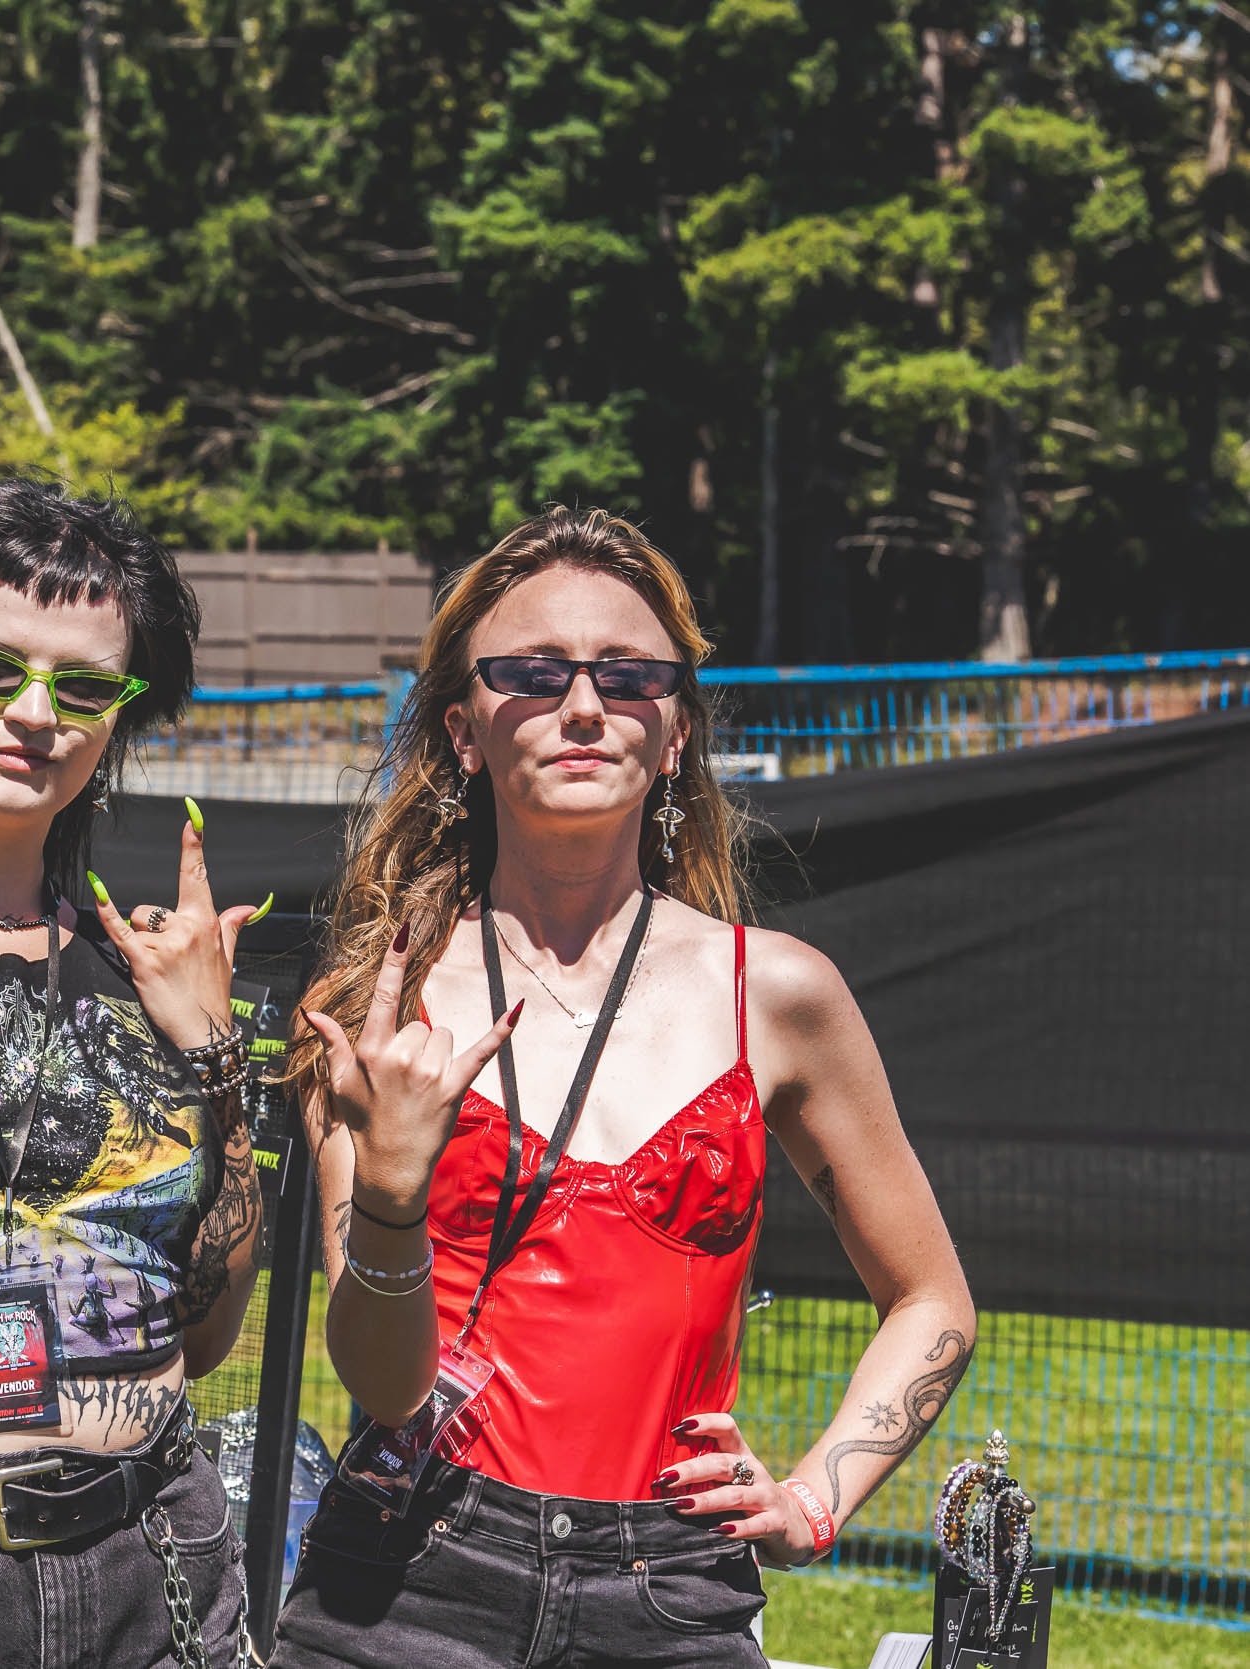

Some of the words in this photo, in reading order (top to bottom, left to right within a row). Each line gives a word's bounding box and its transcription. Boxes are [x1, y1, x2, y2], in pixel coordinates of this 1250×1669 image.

[230, 998, 256, 1019] TRIX
[15, 1310, 37, 1324] ROCK
[378, 1448, 403, 1470] VENDOR
[792, 1483, 826, 1522] VERIFIED
[817, 1520, 831, 1541] AGE
